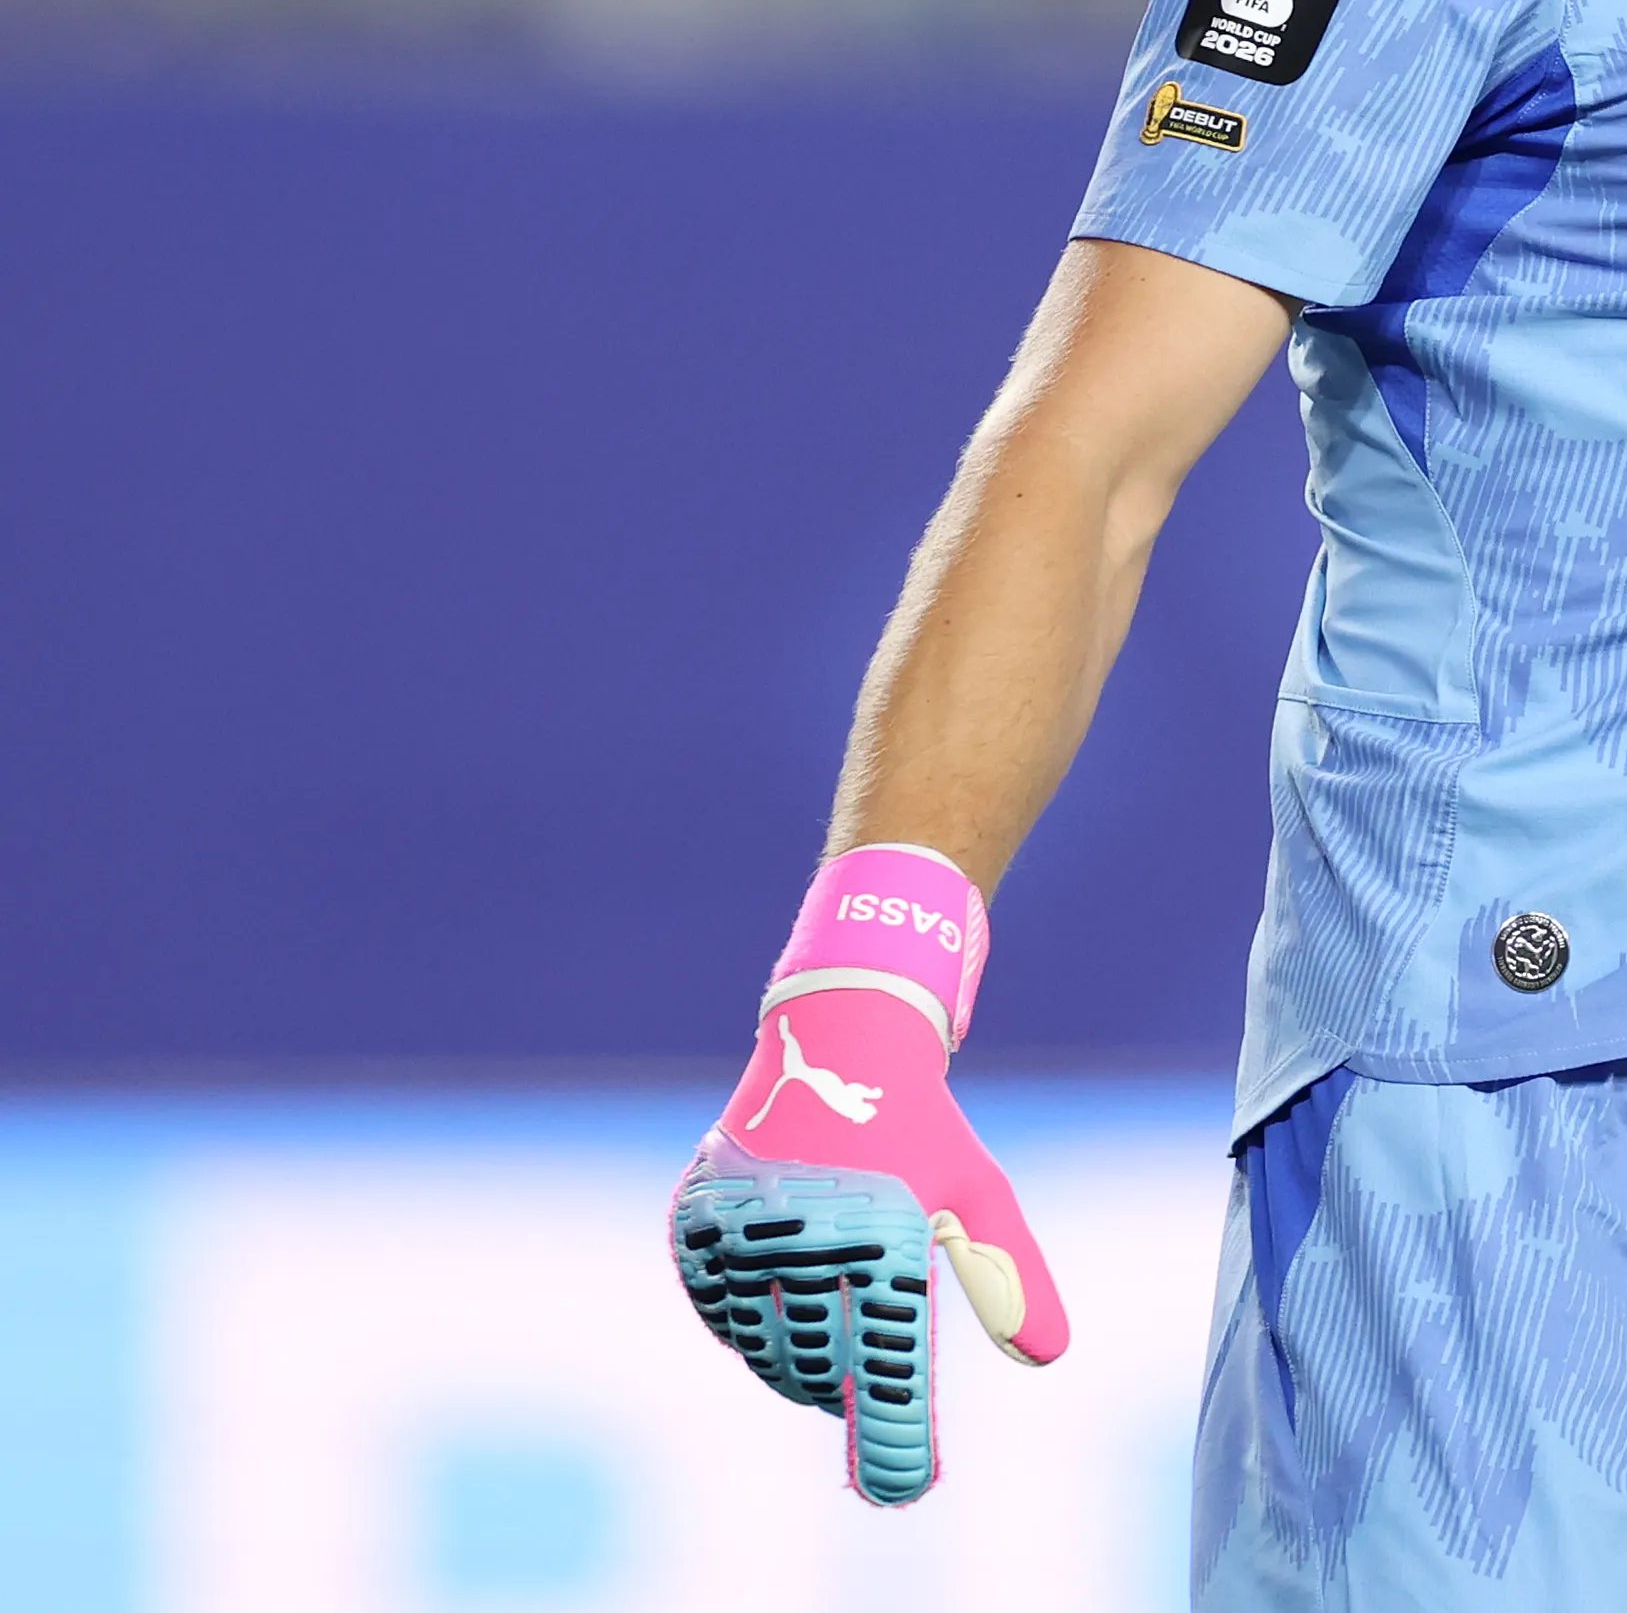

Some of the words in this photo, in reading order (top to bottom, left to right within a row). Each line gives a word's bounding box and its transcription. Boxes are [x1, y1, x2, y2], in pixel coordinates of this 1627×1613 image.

[1210, 16, 1254, 39] WORLD
[1253, 30, 1282, 47] CUP
[1200, 30, 1275, 67] 2026
[1169, 107, 1238, 133] DEBUT
[1185, 124, 1213, 138] WORLD
[1212, 131, 1230, 142] CUP
[836, 894, 962, 953] GASSI
